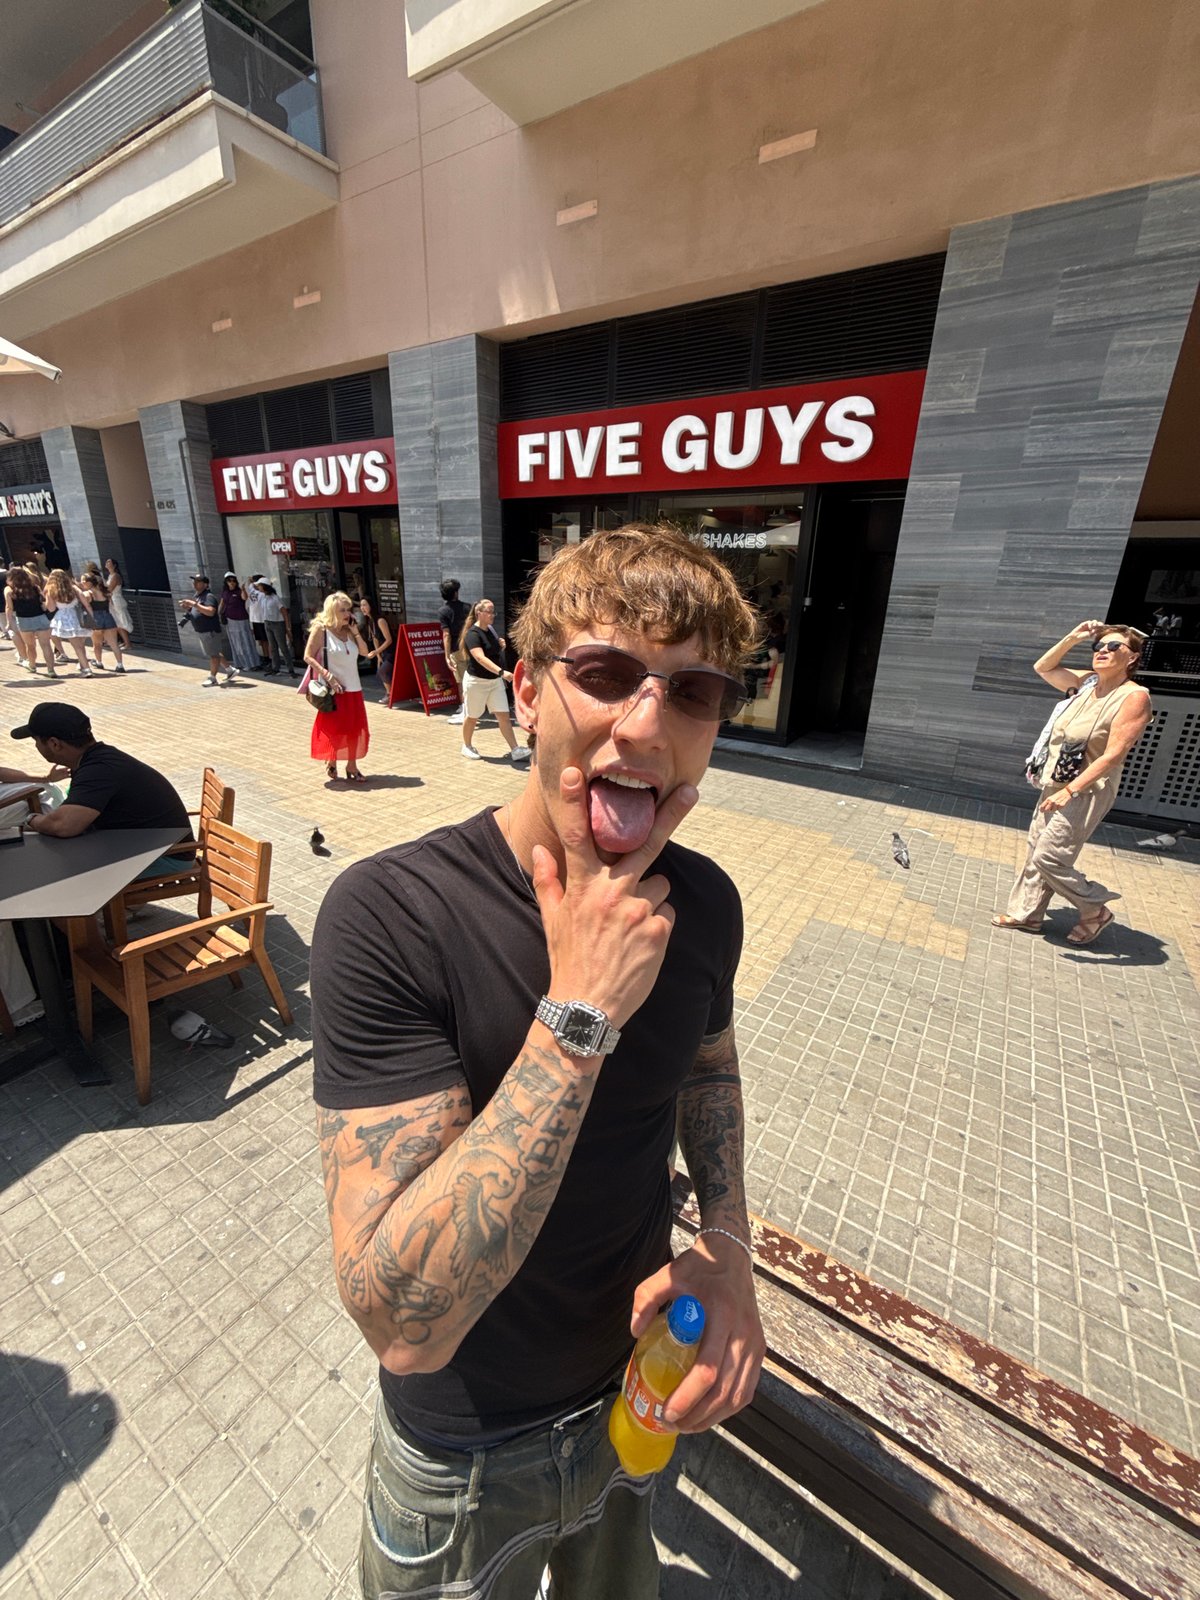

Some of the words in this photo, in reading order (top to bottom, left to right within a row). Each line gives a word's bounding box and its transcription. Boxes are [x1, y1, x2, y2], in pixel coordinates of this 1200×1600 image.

[517, 421, 642, 482] FIVE
[661, 395, 877, 473] GUYS
[222, 462, 288, 502] FIVE
[292, 450, 389, 497] GUYS
[13, 489, 55, 517] JERRY'S
[272, 541, 292, 552] OPEN
[295, 578, 308, 586] FIVE
[525, 1080, 584, 1170] BFF
